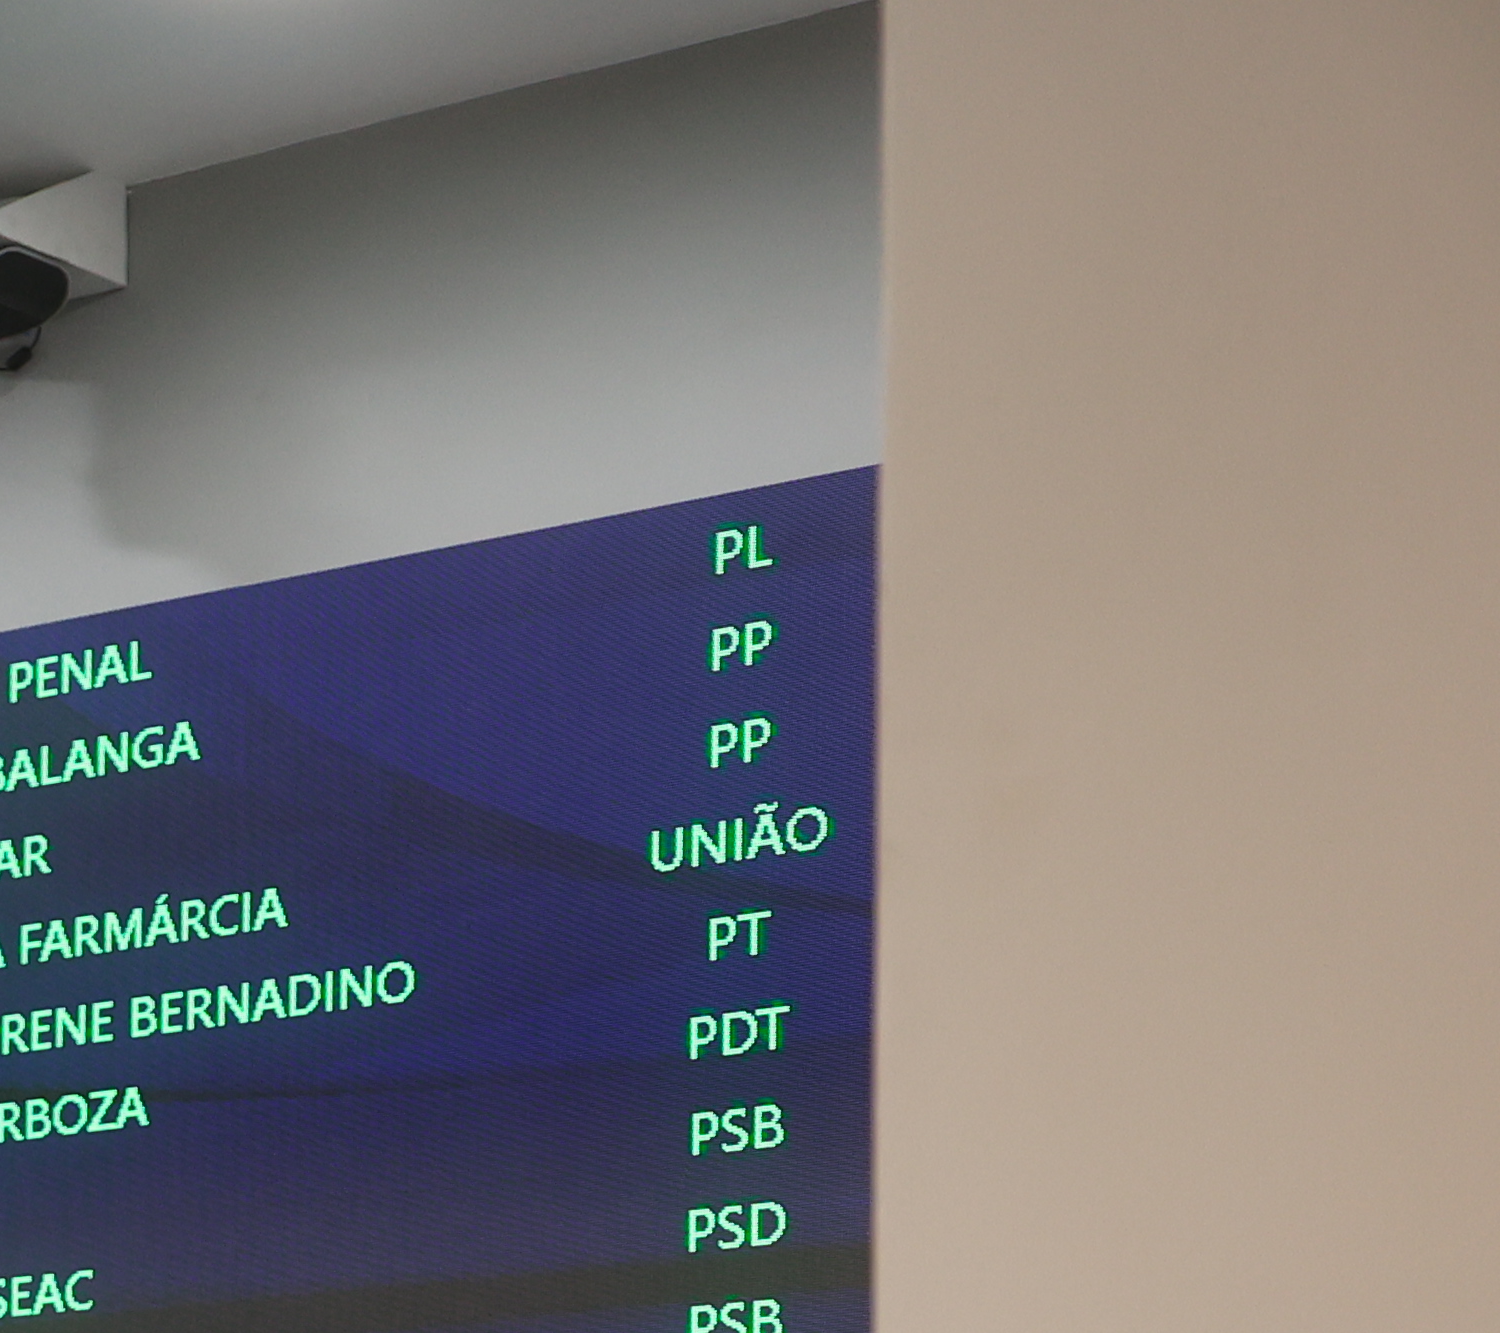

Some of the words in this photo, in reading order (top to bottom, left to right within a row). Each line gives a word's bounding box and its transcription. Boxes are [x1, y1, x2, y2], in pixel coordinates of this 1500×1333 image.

[715, 525, 773, 575] PL
[9, 640, 153, 704] PENAL
[711, 620, 773, 672] PP
[709, 717, 771, 769] PP
[650, 801, 828, 873] UNIÃO
[19, 887, 289, 965] FARMÁRCIA
[708, 910, 772, 962] PT
[130, 960, 415, 1038] BERNADINO
[689, 1005, 791, 1060] PDT
[691, 1104, 785, 1156] PSB
[687, 1201, 786, 1253] PSD
